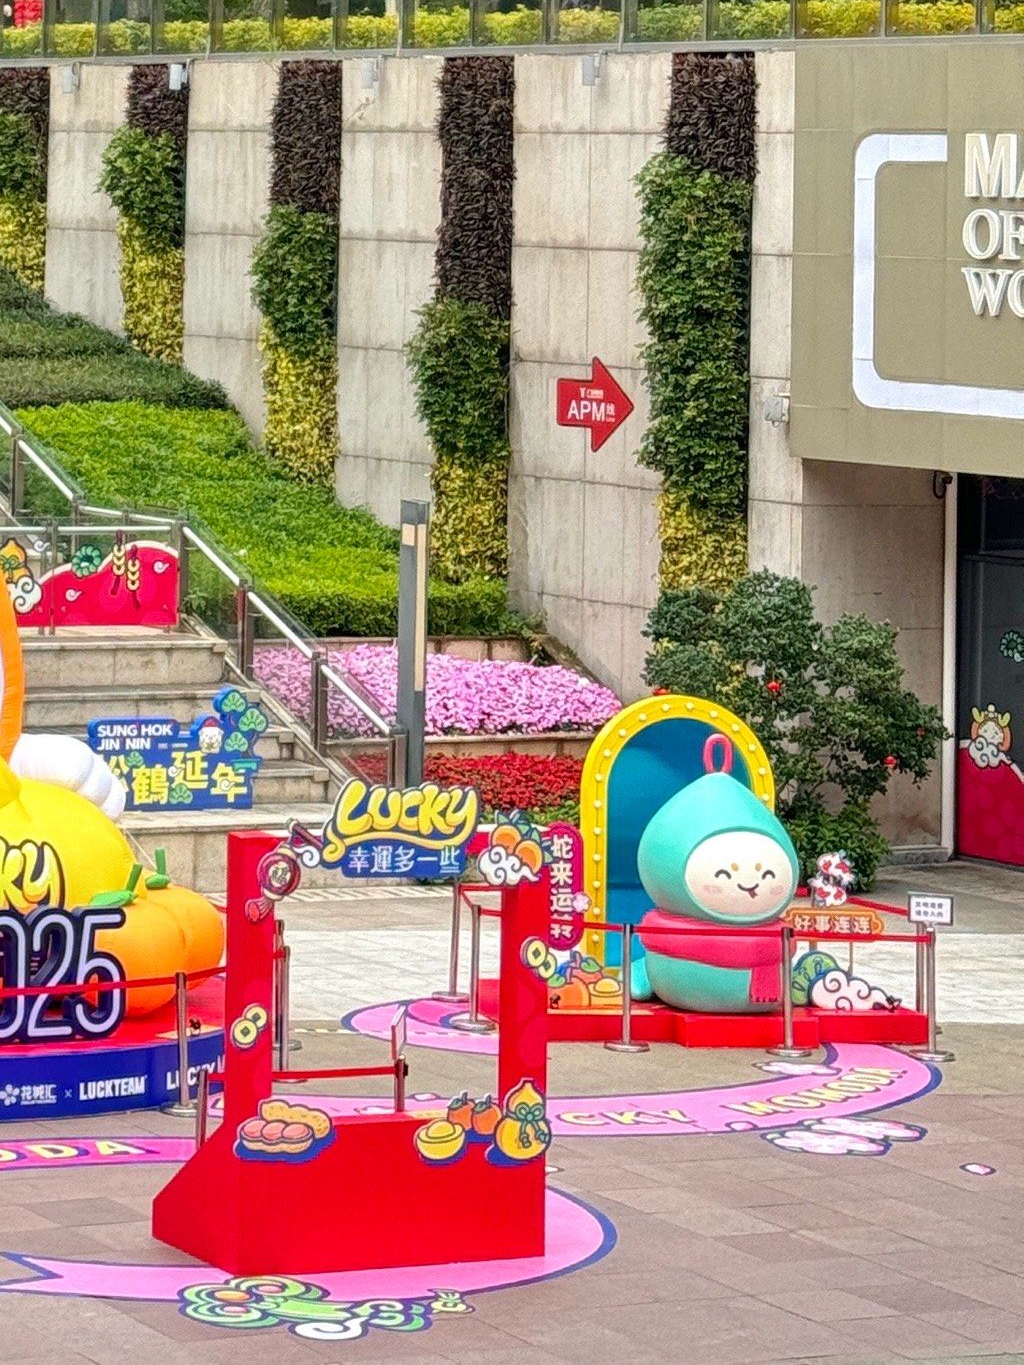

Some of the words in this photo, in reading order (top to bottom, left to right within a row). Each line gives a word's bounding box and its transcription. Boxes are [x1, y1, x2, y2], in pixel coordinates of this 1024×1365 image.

[964, 133, 1024, 198] M
[962, 208, 1024, 260] OF
[567, 399, 606, 423] APM
[97, 724, 138, 738] SUNG
[141, 724, 174, 736] HOK
[97, 738, 120, 751] JIN
[125, 737, 151, 751] NIN
[328, 779, 478, 847] LUCKY
[347, 844, 461, 874] 幸運多一些
[549, 833, 574, 939] 蛇来运转
[79, 1076, 146, 1101] LUCKTEAM
[556, 1107, 695, 1128] CKY
